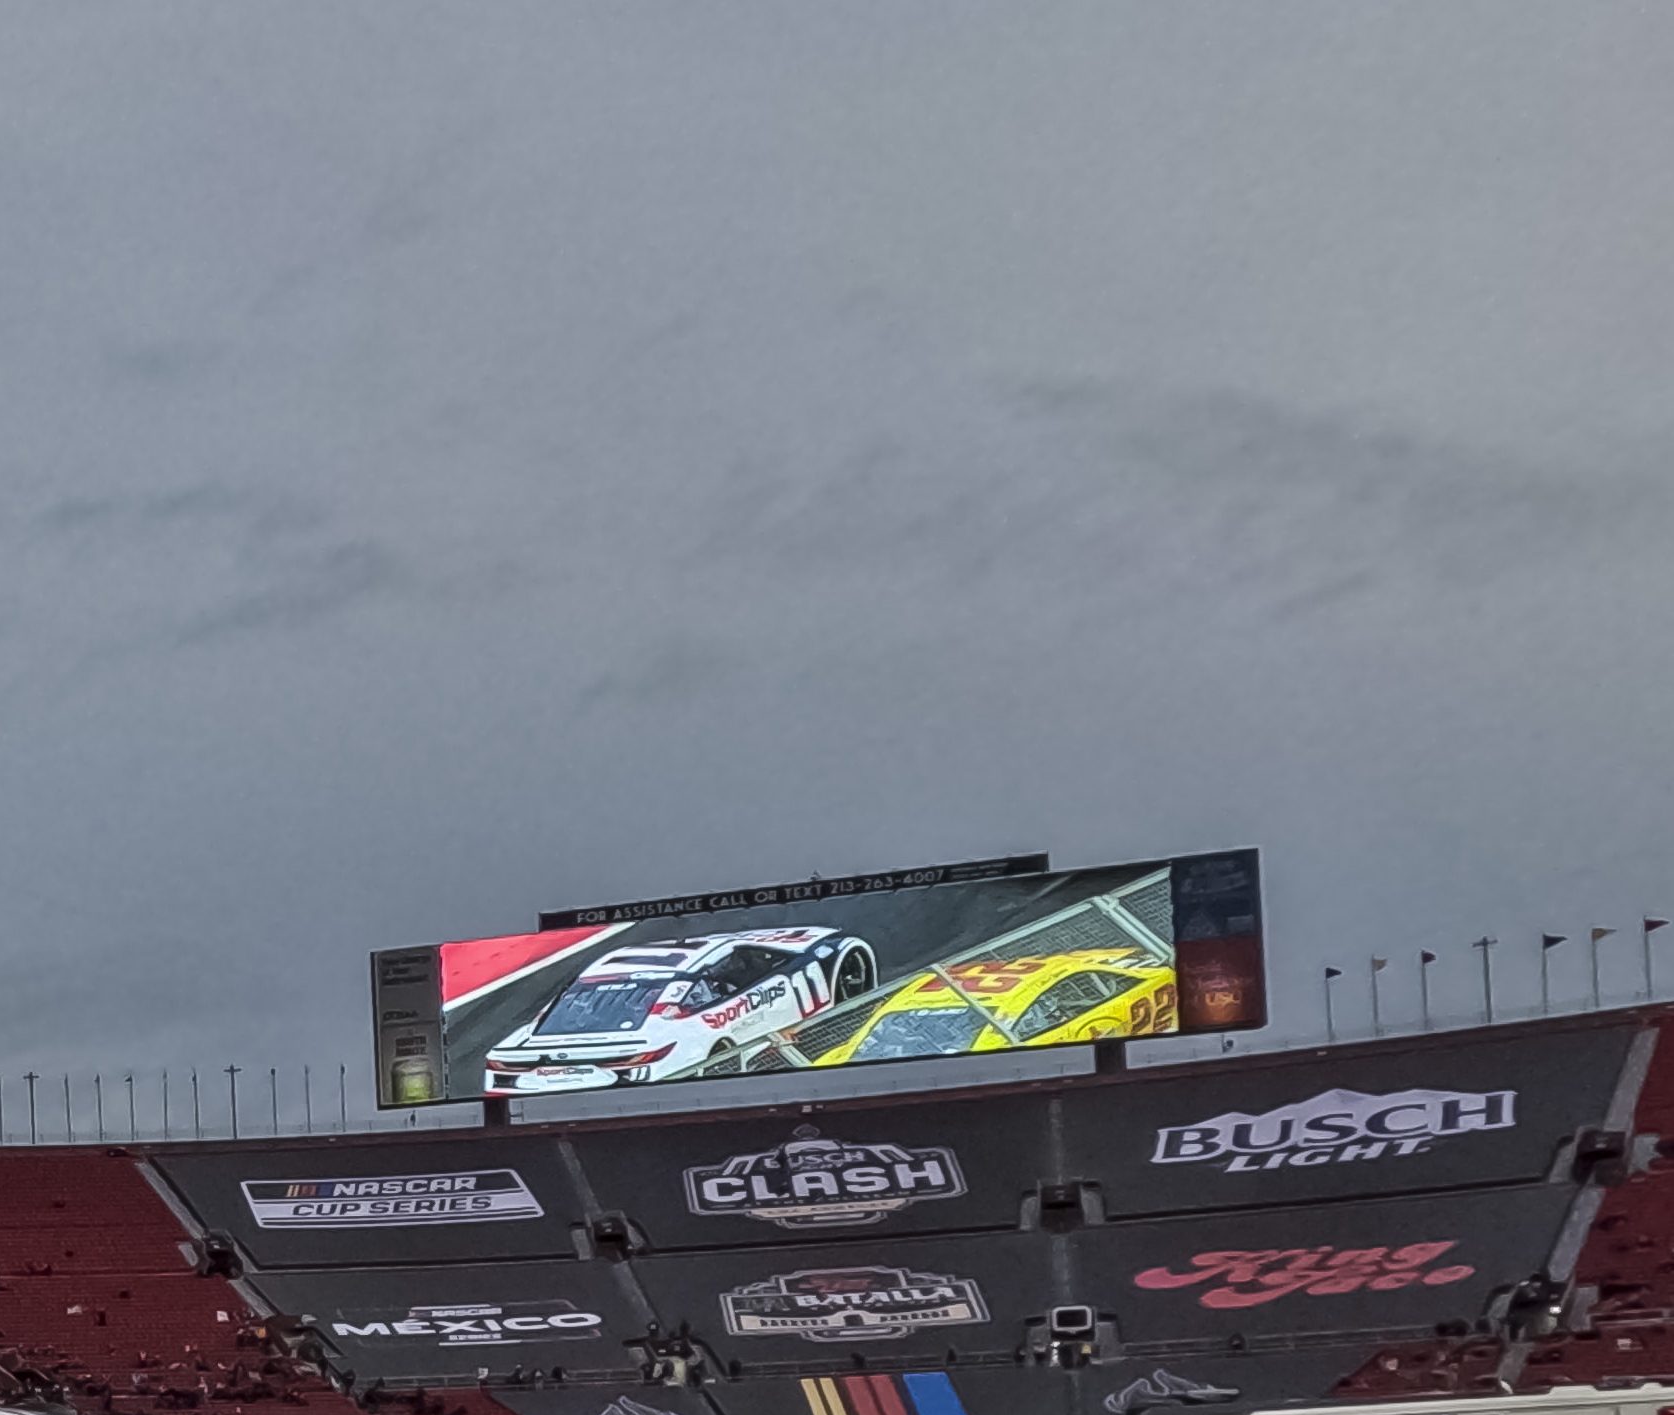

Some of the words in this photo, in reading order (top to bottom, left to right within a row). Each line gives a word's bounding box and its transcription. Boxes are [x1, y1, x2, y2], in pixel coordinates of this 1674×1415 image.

[577, 912, 606, 924] FOR
[613, 900, 702, 919] ASSISTANCE
[709, 895, 748, 909] CALL
[755, 890, 778, 904] OR
[785, 884, 822, 900] TEXT
[1155, 1091, 1513, 1162] BUSCH
[1225, 1138, 1434, 1172] LIGHT
[333, 1176, 476, 1198] NASCAR
[702, 1160, 945, 1202] CLASH
[292, 1201, 362, 1217] CUP
[368, 1196, 493, 1215] SERIES
